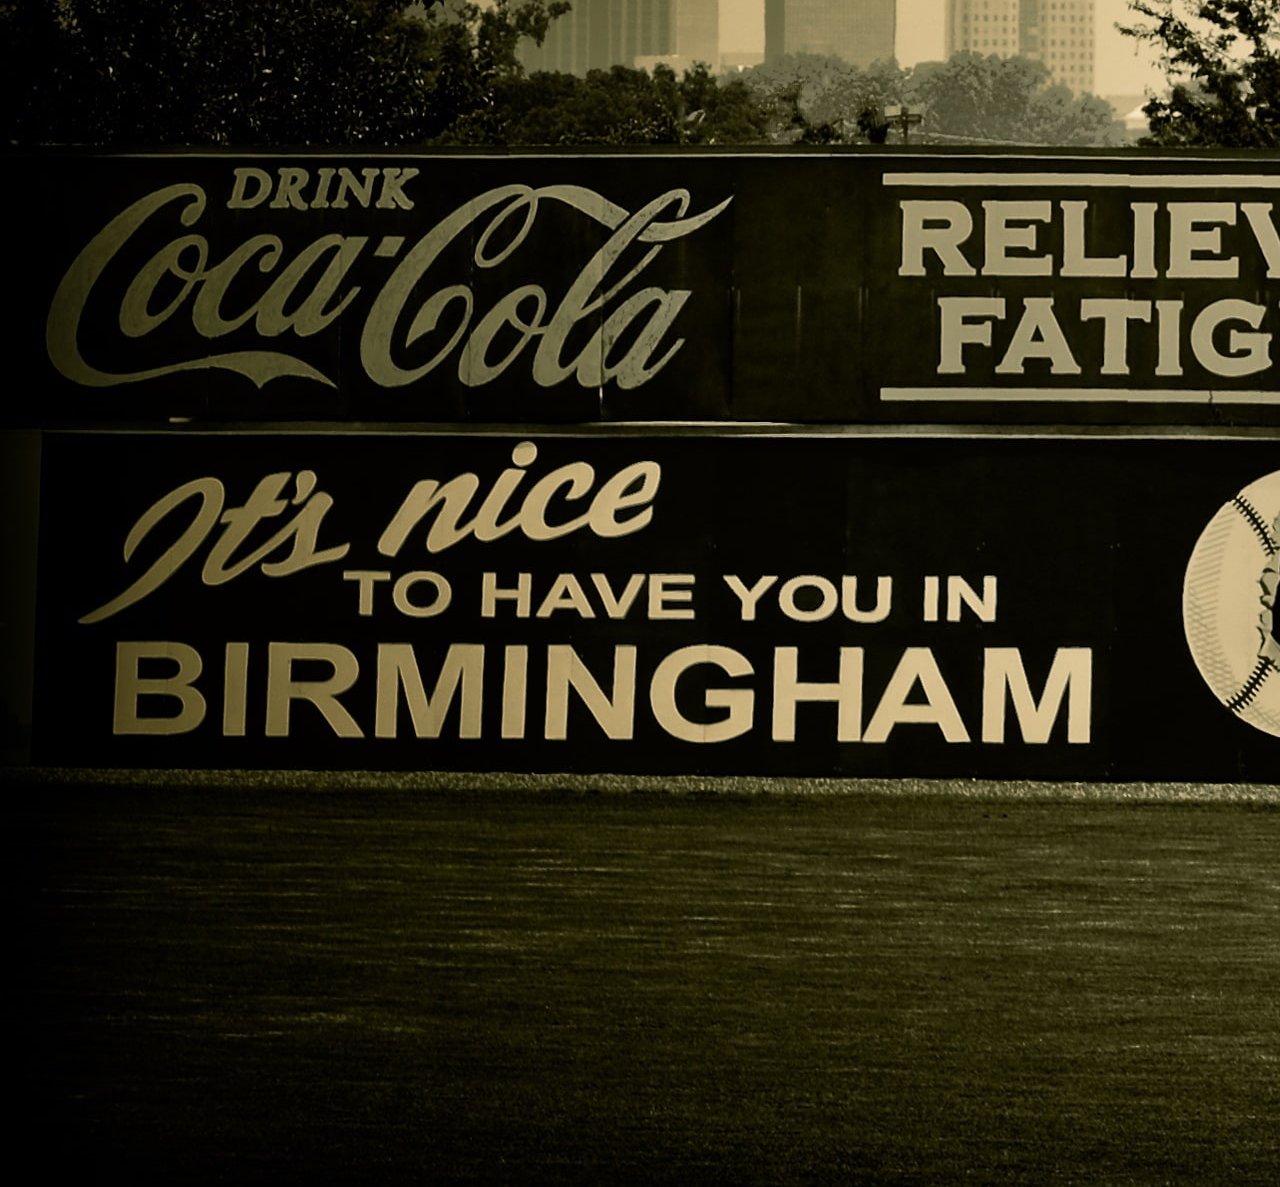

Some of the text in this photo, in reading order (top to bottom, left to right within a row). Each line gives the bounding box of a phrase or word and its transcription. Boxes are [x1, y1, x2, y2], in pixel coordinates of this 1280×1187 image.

[226, 167, 420, 211] DRINK
[45, 182, 733, 389] Coca-Cola
[76, 440, 662, 626] It's nice
[342, 570, 998, 623] TO HAVE YOU IN
[111, 639, 1093, 744] BIRMINGHAM
